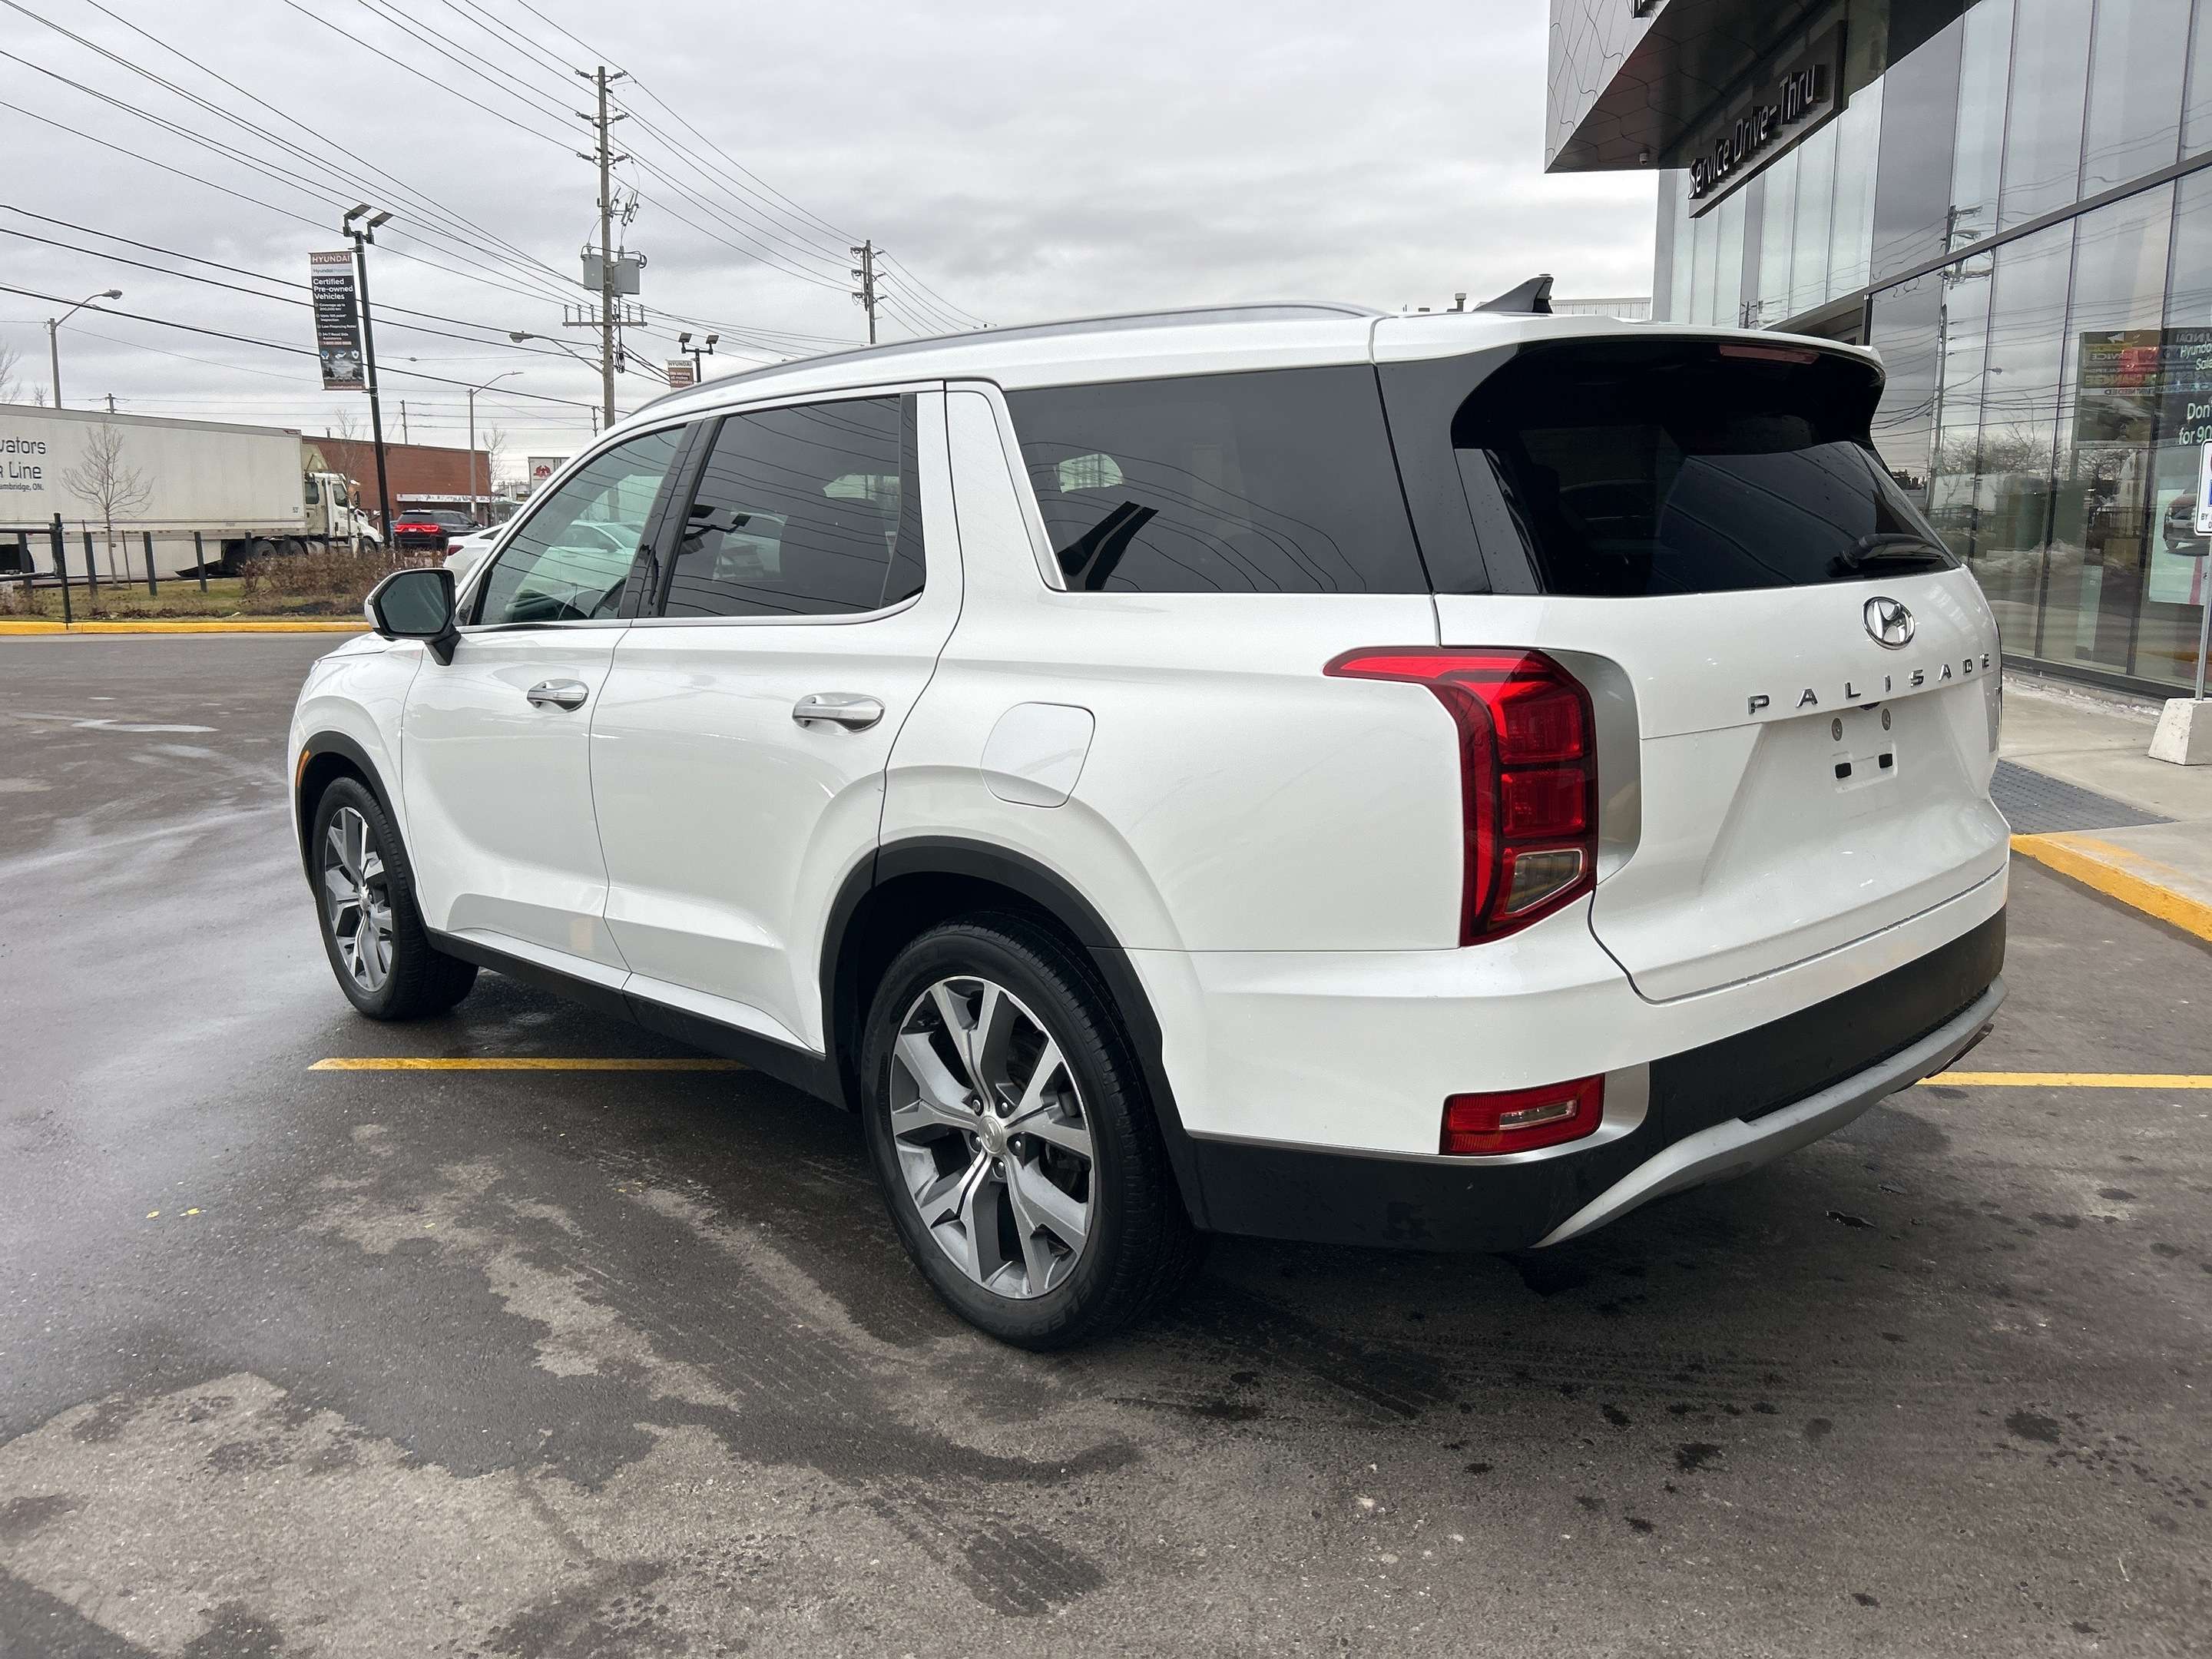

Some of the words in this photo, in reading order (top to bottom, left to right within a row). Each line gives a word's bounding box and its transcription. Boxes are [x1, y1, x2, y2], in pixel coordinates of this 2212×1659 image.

[1688, 138, 1730, 200] Service
[1734, 65, 1816, 164] Drive-Thru
[2179, 427, 2195, 445] for
[8, 461, 42, 479] Line
[2200, 512, 2209, 521] BY
[1747, 653, 1991, 715] PALISADE
